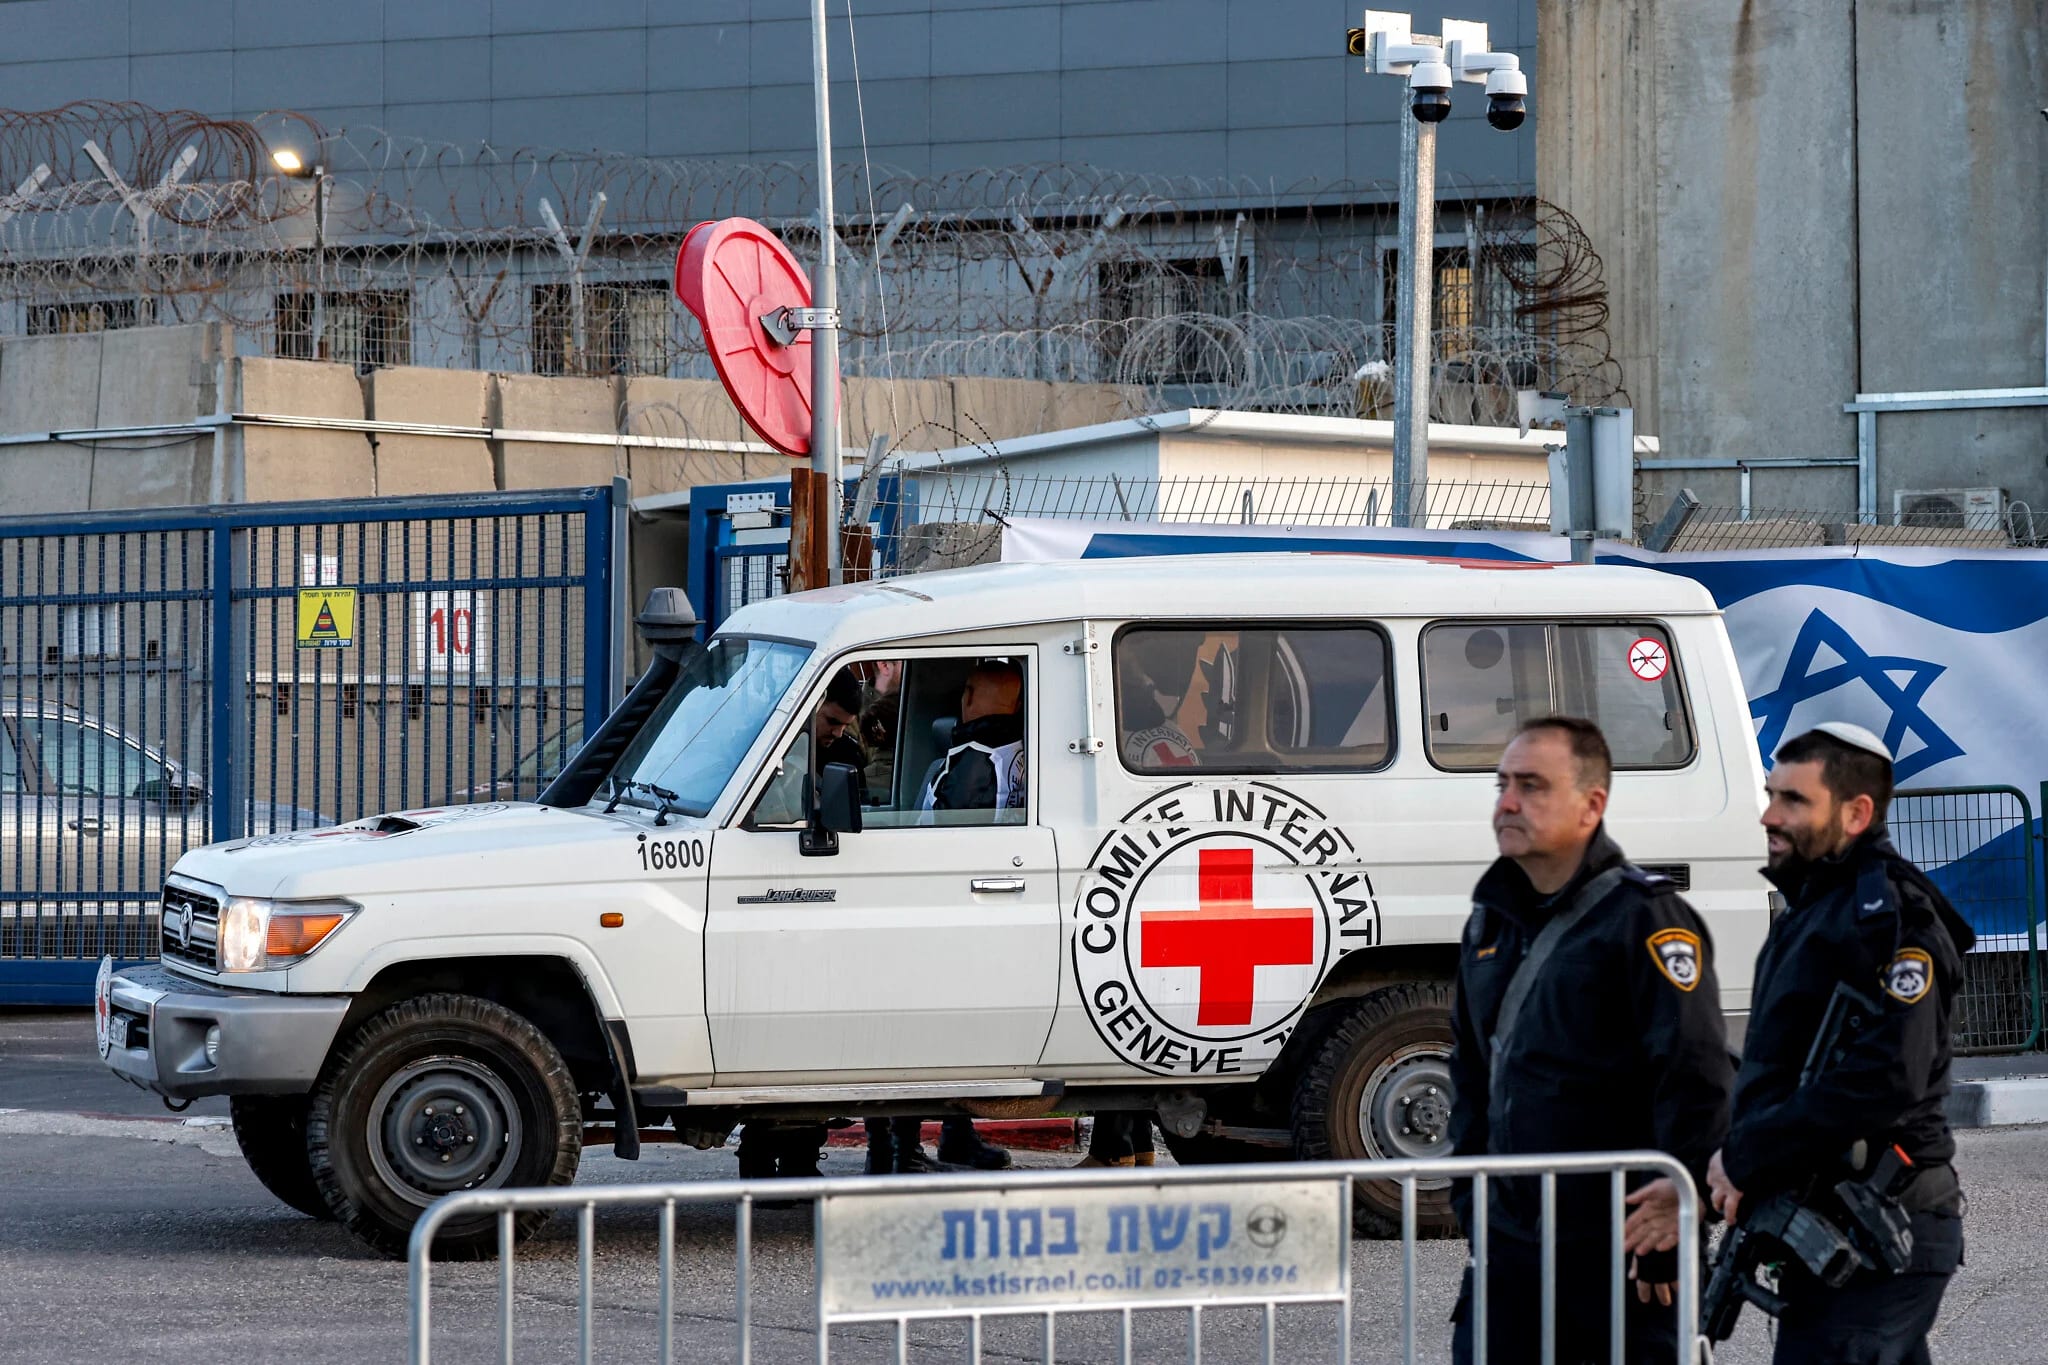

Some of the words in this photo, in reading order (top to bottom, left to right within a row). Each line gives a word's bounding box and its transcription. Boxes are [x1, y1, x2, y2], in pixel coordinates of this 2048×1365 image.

[430, 607, 473, 655] 10
[637, 838, 705, 871] 16800
[1082, 799, 1191, 954] COMITE
[1213, 789, 1373, 956] INTERNAT
[1094, 980, 1243, 1074] GENEVE
[940, 1206, 1079, 1261] במות
[1105, 1202, 1231, 1261] קשת
[871, 1265, 1142, 1299] www.kstisrael.co.il
[1153, 1264, 1299, 1290] 02-5839696
